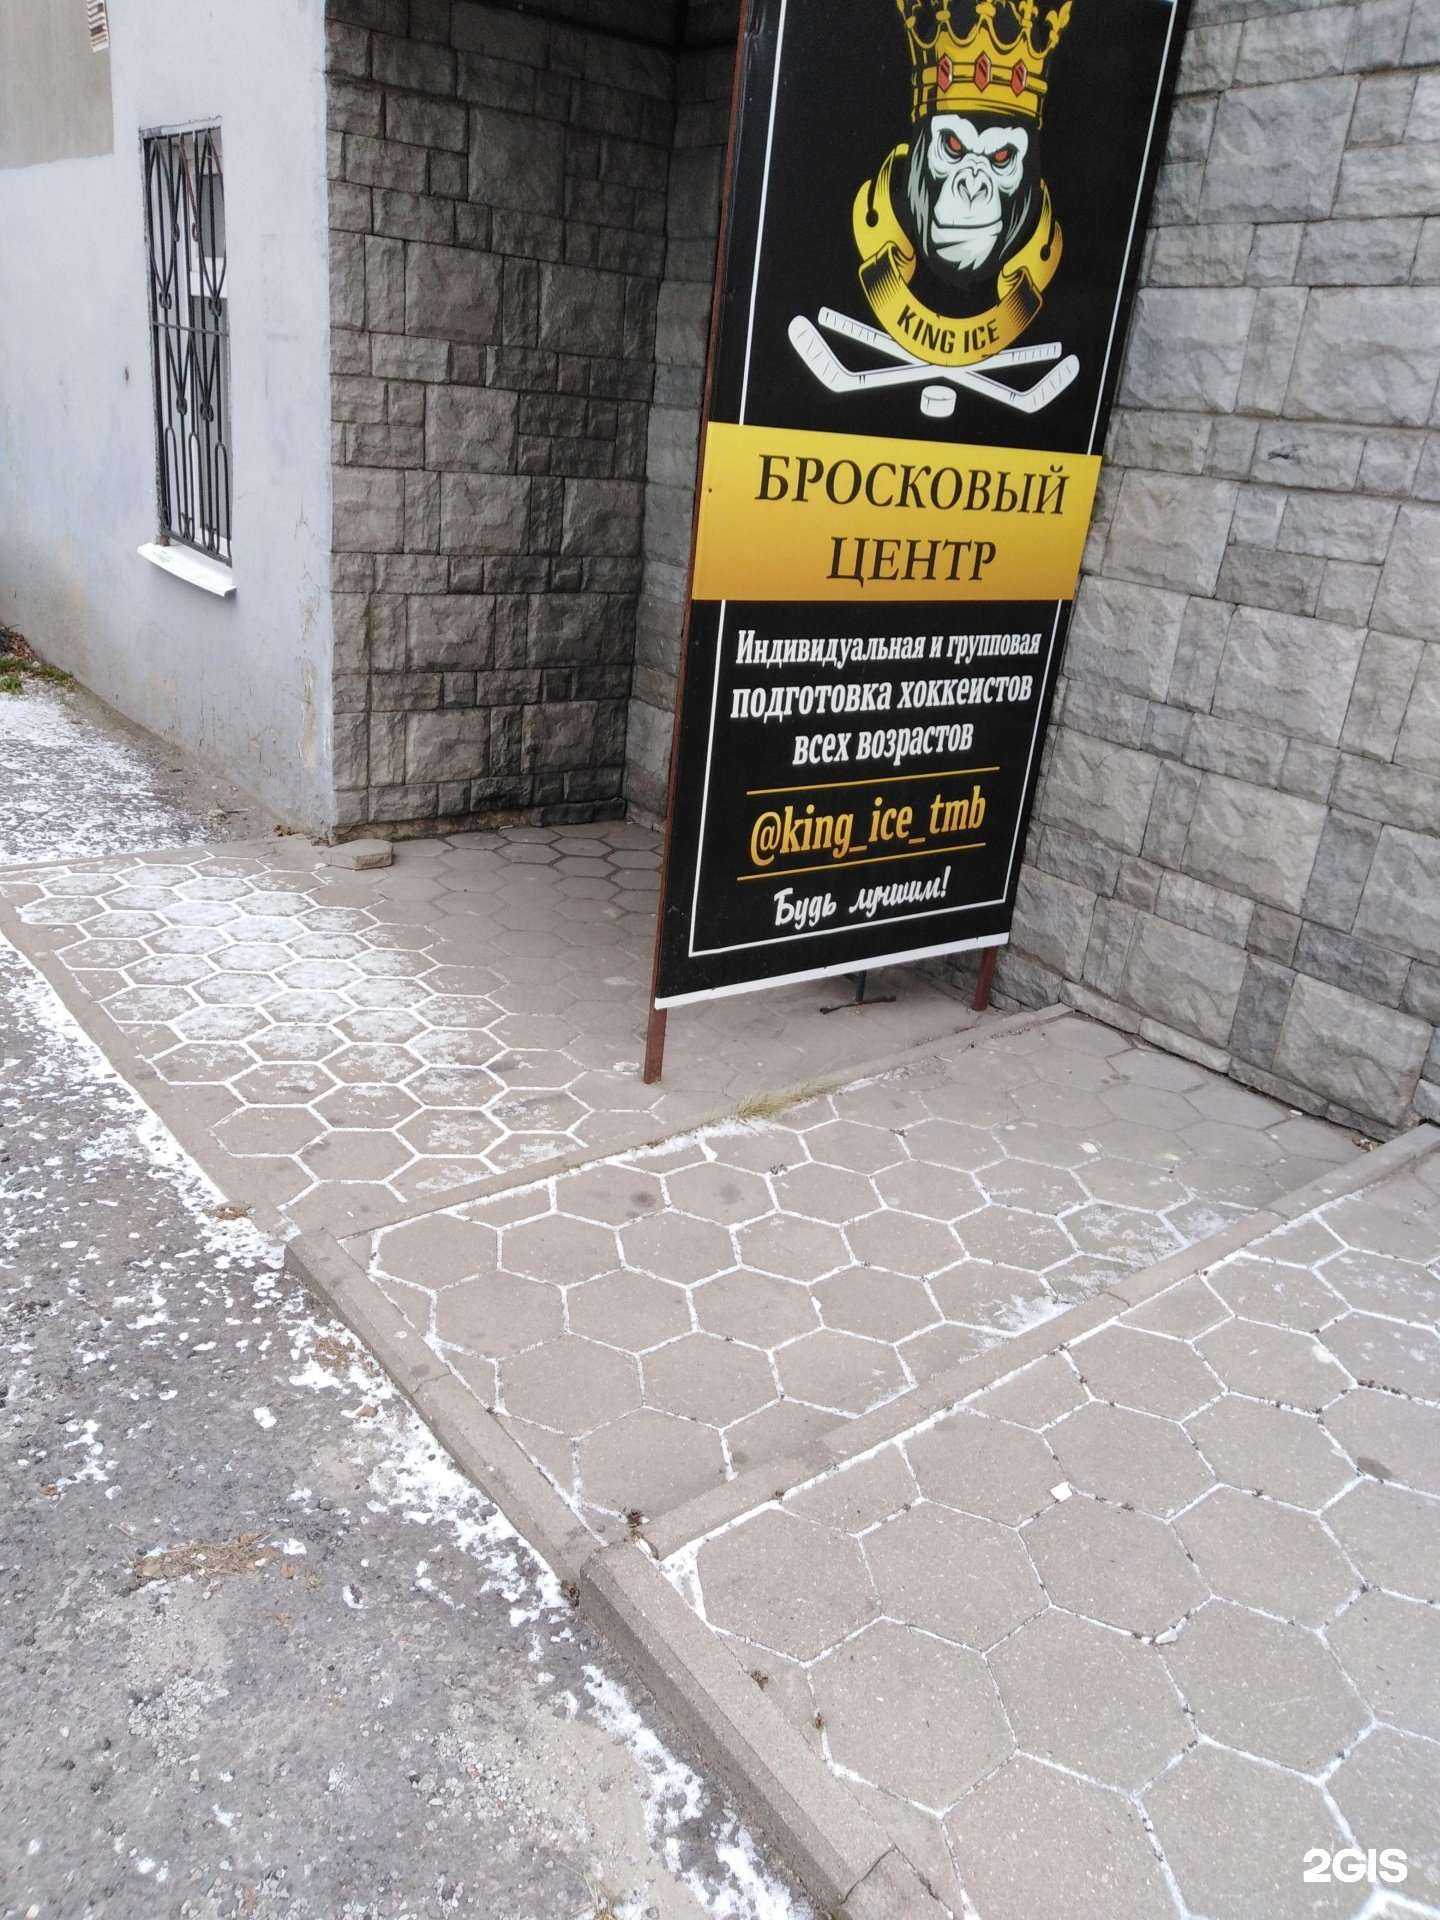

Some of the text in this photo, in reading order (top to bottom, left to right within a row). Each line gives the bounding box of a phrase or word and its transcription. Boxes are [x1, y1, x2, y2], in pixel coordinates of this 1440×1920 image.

[897, 304, 1000, 354] KING ICE
[755, 453, 1070, 515] БРОСКОВЫЙ
[826, 536, 997, 588] ЦЕНТР
[735, 629, 1042, 670] Индивидуальная и групповая
[730, 674, 1034, 723] подготовка хоккеистов
[792, 723, 975, 766] всех возрастов
[750, 784, 987, 867] @king_ice_tmb
[773, 865, 952, 930] Будь лучшим!
